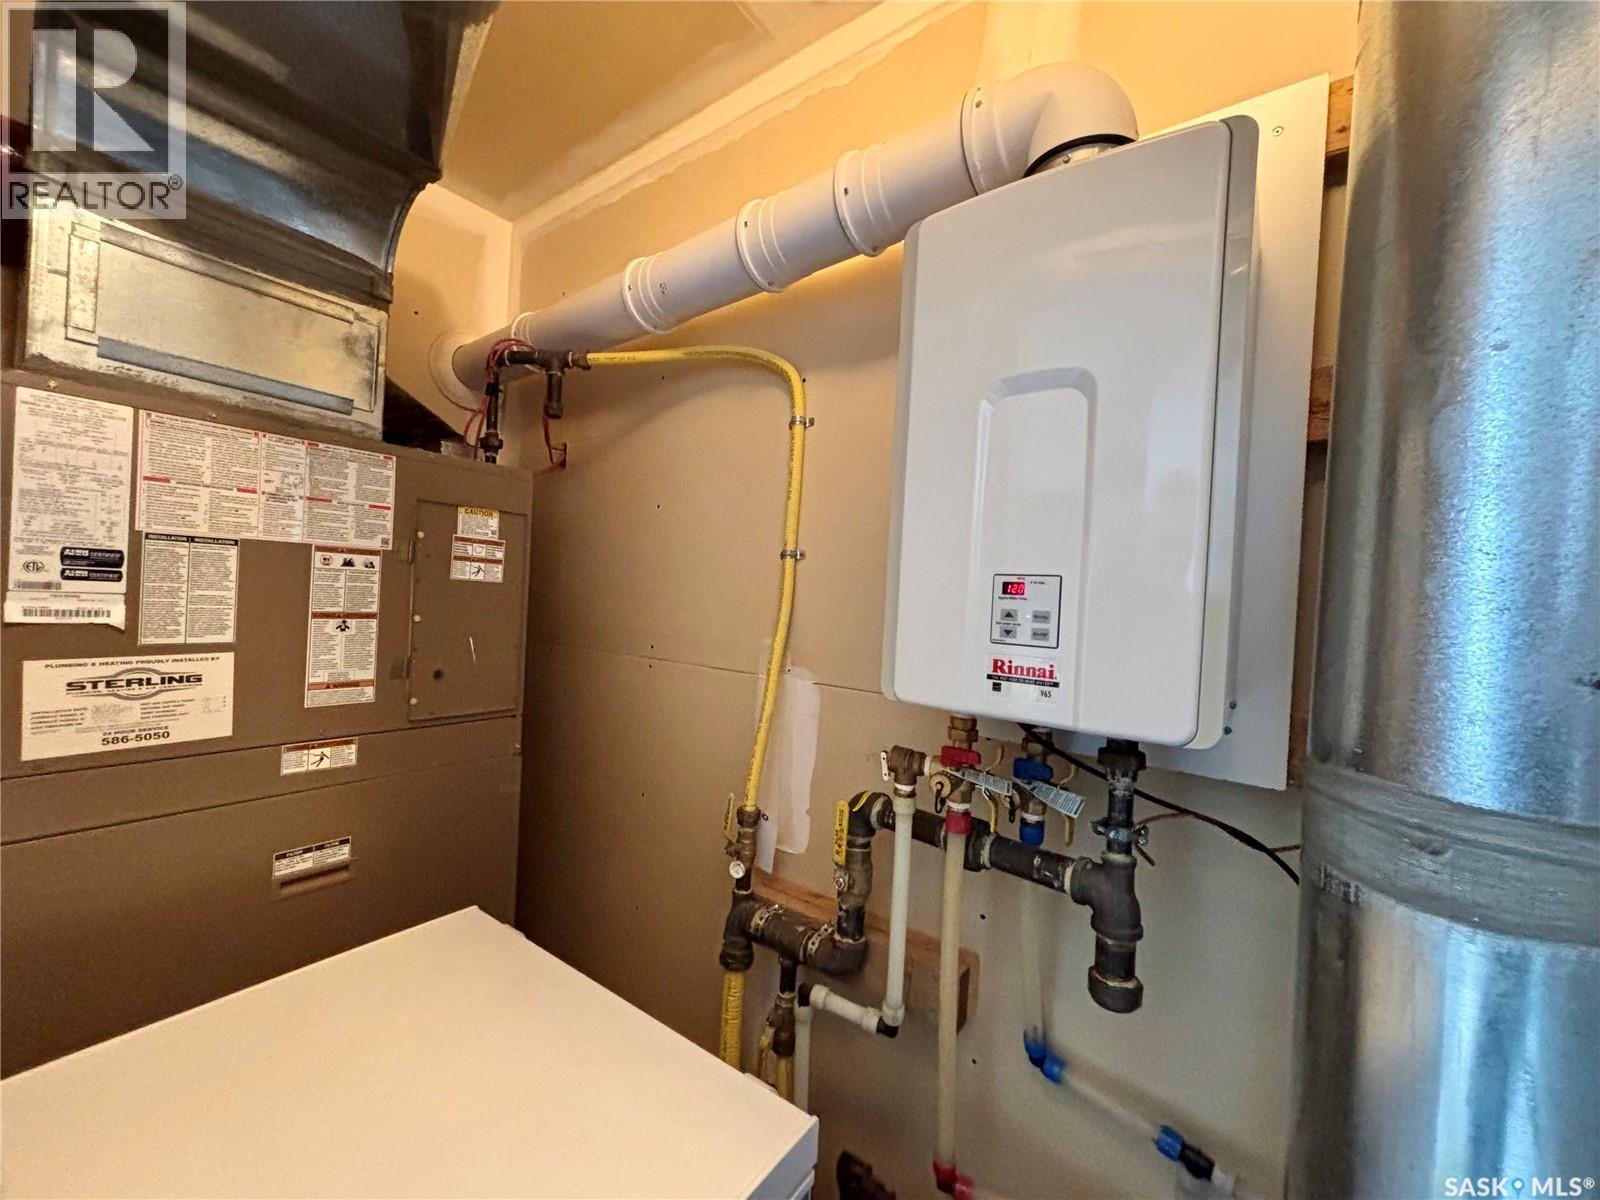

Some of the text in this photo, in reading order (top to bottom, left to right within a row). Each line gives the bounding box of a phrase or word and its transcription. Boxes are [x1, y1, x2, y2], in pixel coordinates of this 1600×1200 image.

[464, 508, 493, 517] CAUTION
[1007, 584, 1024, 593] 120
[992, 658, 1056, 680] Rinnai
[66, 674, 202, 691] STERLING
[1040, 689, 1052, 698] V65
[101, 731, 170, 745] 586-5050
